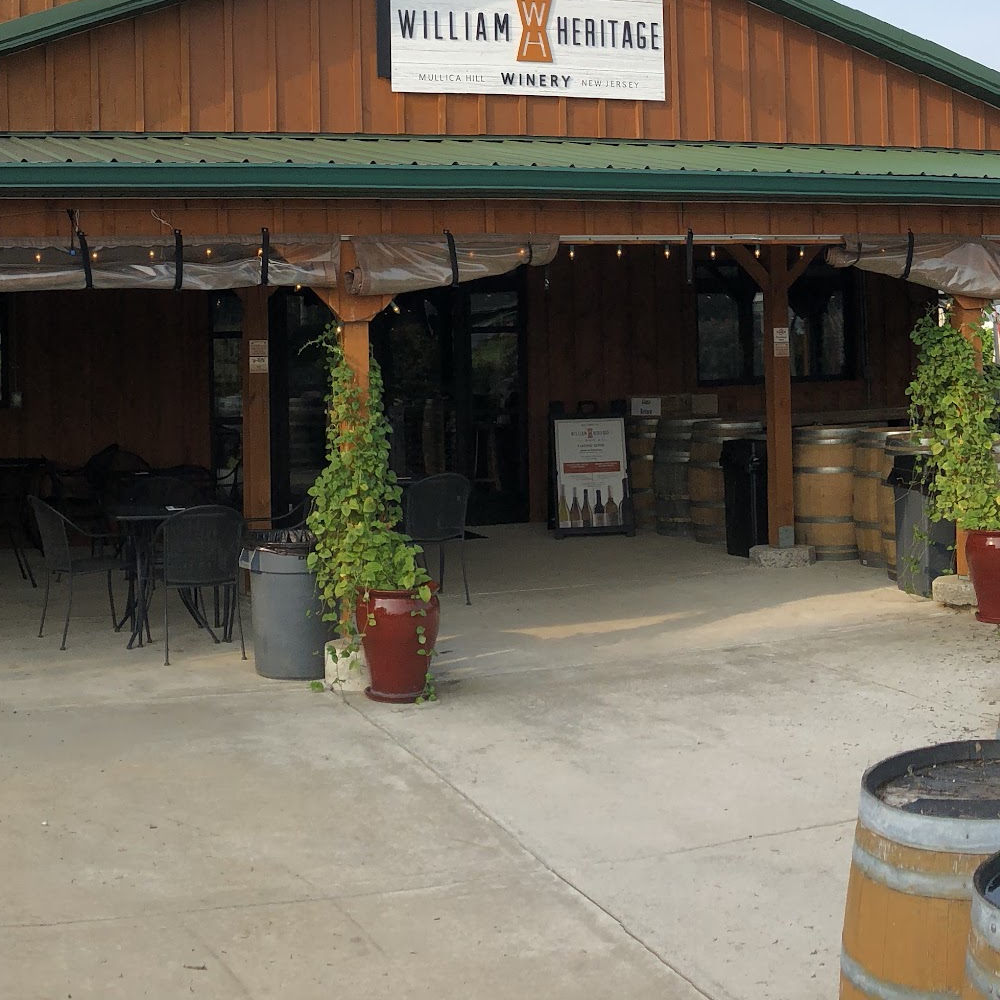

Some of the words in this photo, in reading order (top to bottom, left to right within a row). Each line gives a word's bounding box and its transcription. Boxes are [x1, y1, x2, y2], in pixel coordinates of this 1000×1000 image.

[522, 0, 545, 26] W
[398, 9, 510, 42] WILLIAM
[557, 16, 660, 50] HERITAGE
[418, 73, 462, 83] MULLICA
[465, 74, 486, 83] HILL
[501, 72, 571, 88] WINERY
[581, 79, 602, 88] NEW
[605, 80, 640, 89] JERSEY
